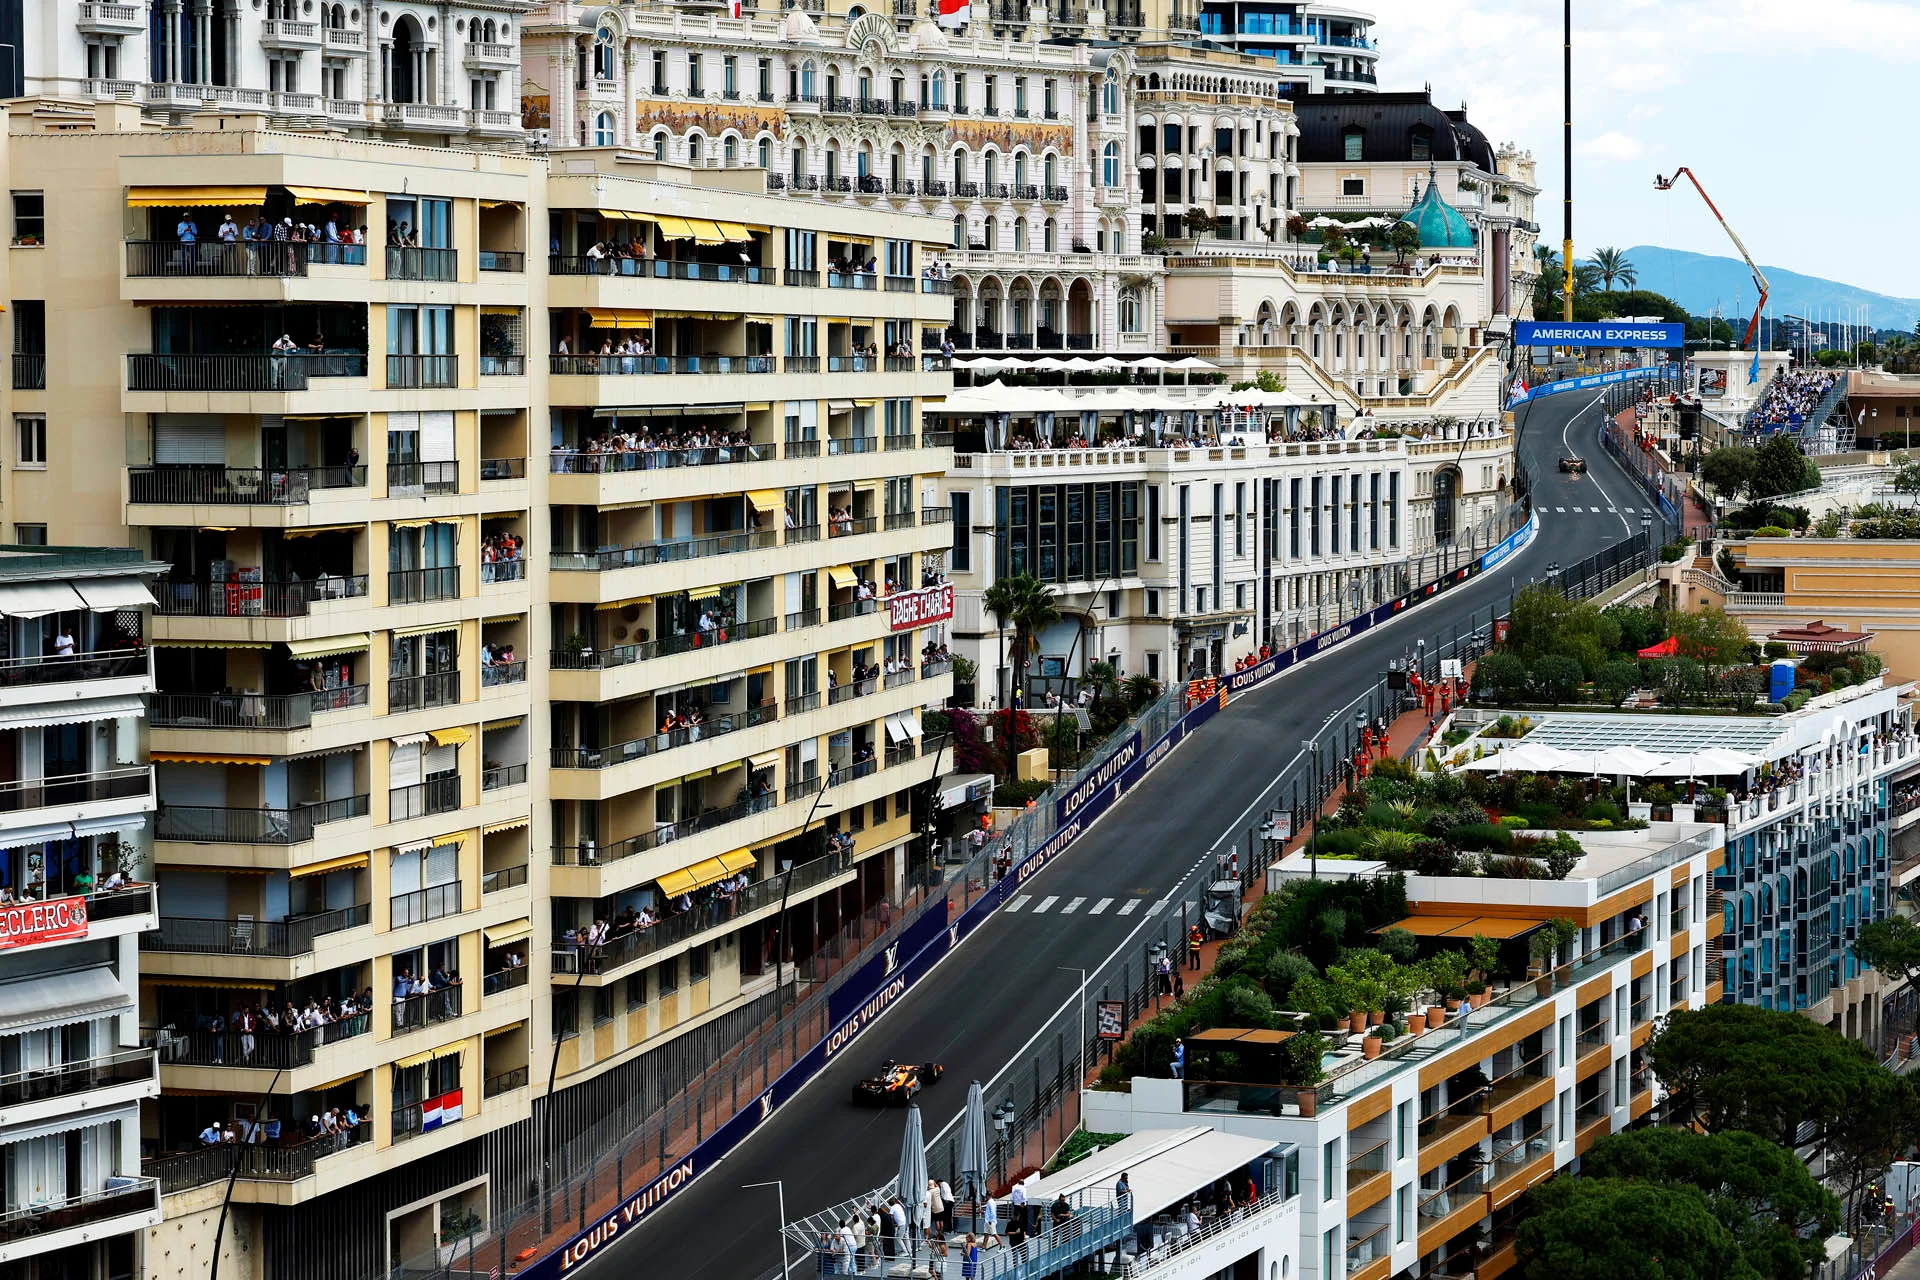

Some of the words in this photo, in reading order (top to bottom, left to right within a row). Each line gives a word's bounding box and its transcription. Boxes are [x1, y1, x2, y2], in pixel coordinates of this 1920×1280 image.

[1532, 329, 1602, 339] AMERICAN
[1606, 330, 1667, 340] EXPRESS
[893, 596, 918, 625] DAGHE
[1318, 634, 1332, 649] LOUIS
[1332, 624, 1351, 642] VUITTON
[1232, 671, 1254, 688] LOUIS
[1255, 660, 1276, 680] VUITTON
[1146, 751, 1156, 769] LOUIS
[1065, 776, 1095, 817] LOUIS
[1097, 741, 1135, 787] VUITTON
[1018, 850, 1044, 882] LOUIS
[1045, 818, 1081, 858] VUITTON
[826, 1015, 859, 1057] LOUIS
[860, 974, 905, 1023] VUITTON
[562, 1214, 618, 1270] LOUIS
[623, 1158, 693, 1223] VUITTON
